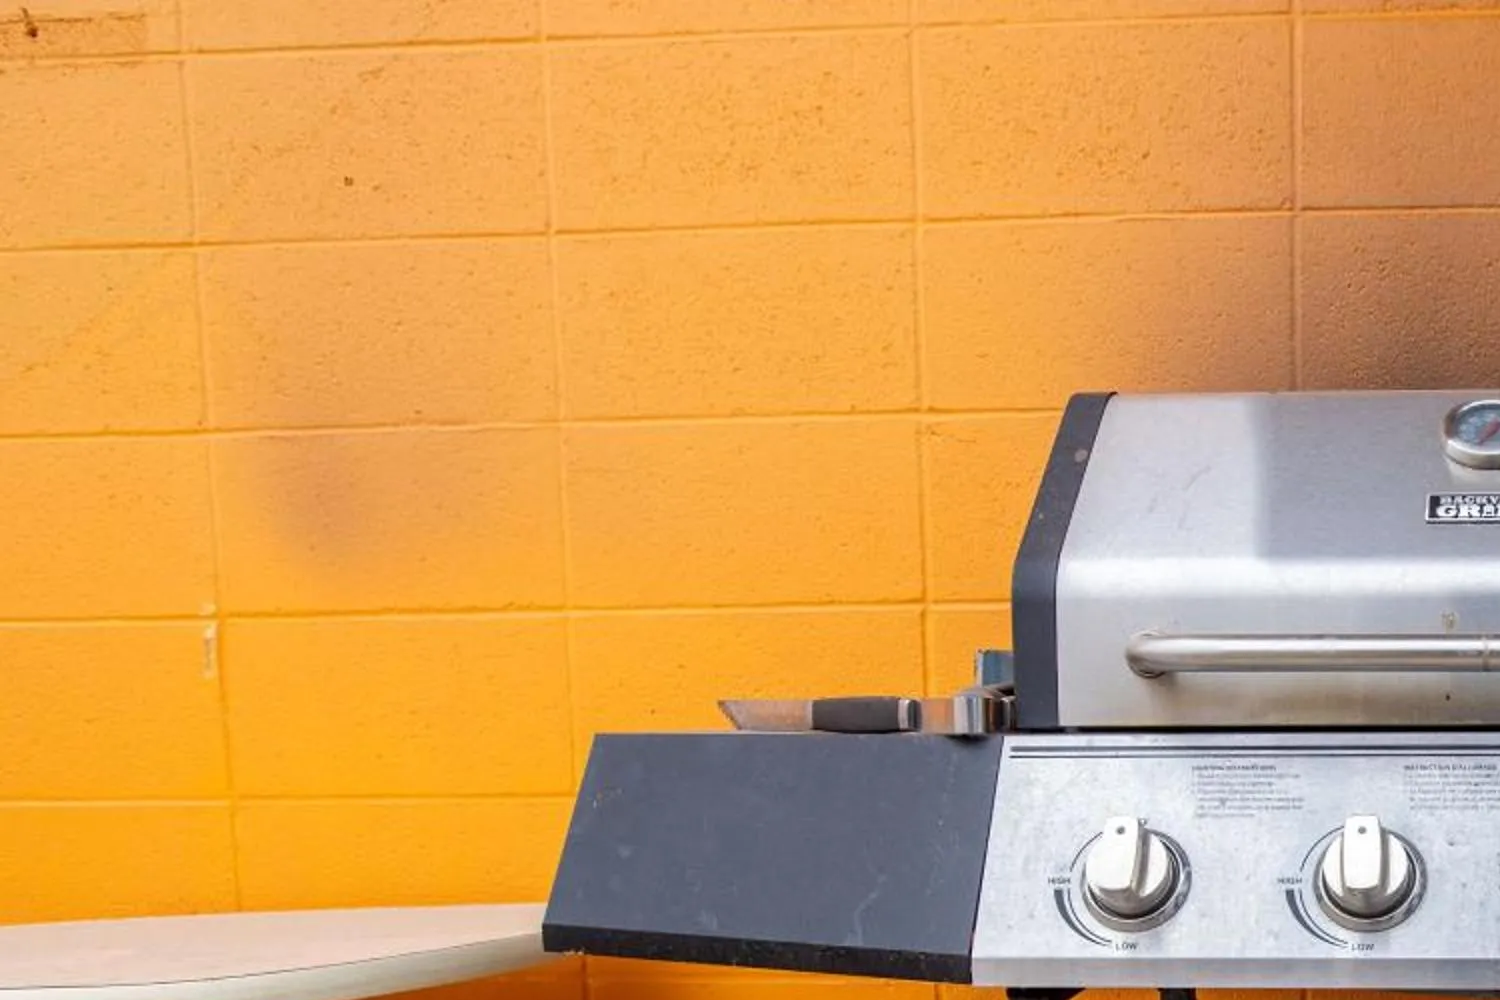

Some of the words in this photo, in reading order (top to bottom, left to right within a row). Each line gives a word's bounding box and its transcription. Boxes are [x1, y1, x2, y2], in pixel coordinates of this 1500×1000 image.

[1048, 877, 1071, 885] HIGH
[1277, 877, 1302, 885] HIGH
[1115, 942, 1138, 951] LOW
[1351, 943, 1375, 951] LOW
